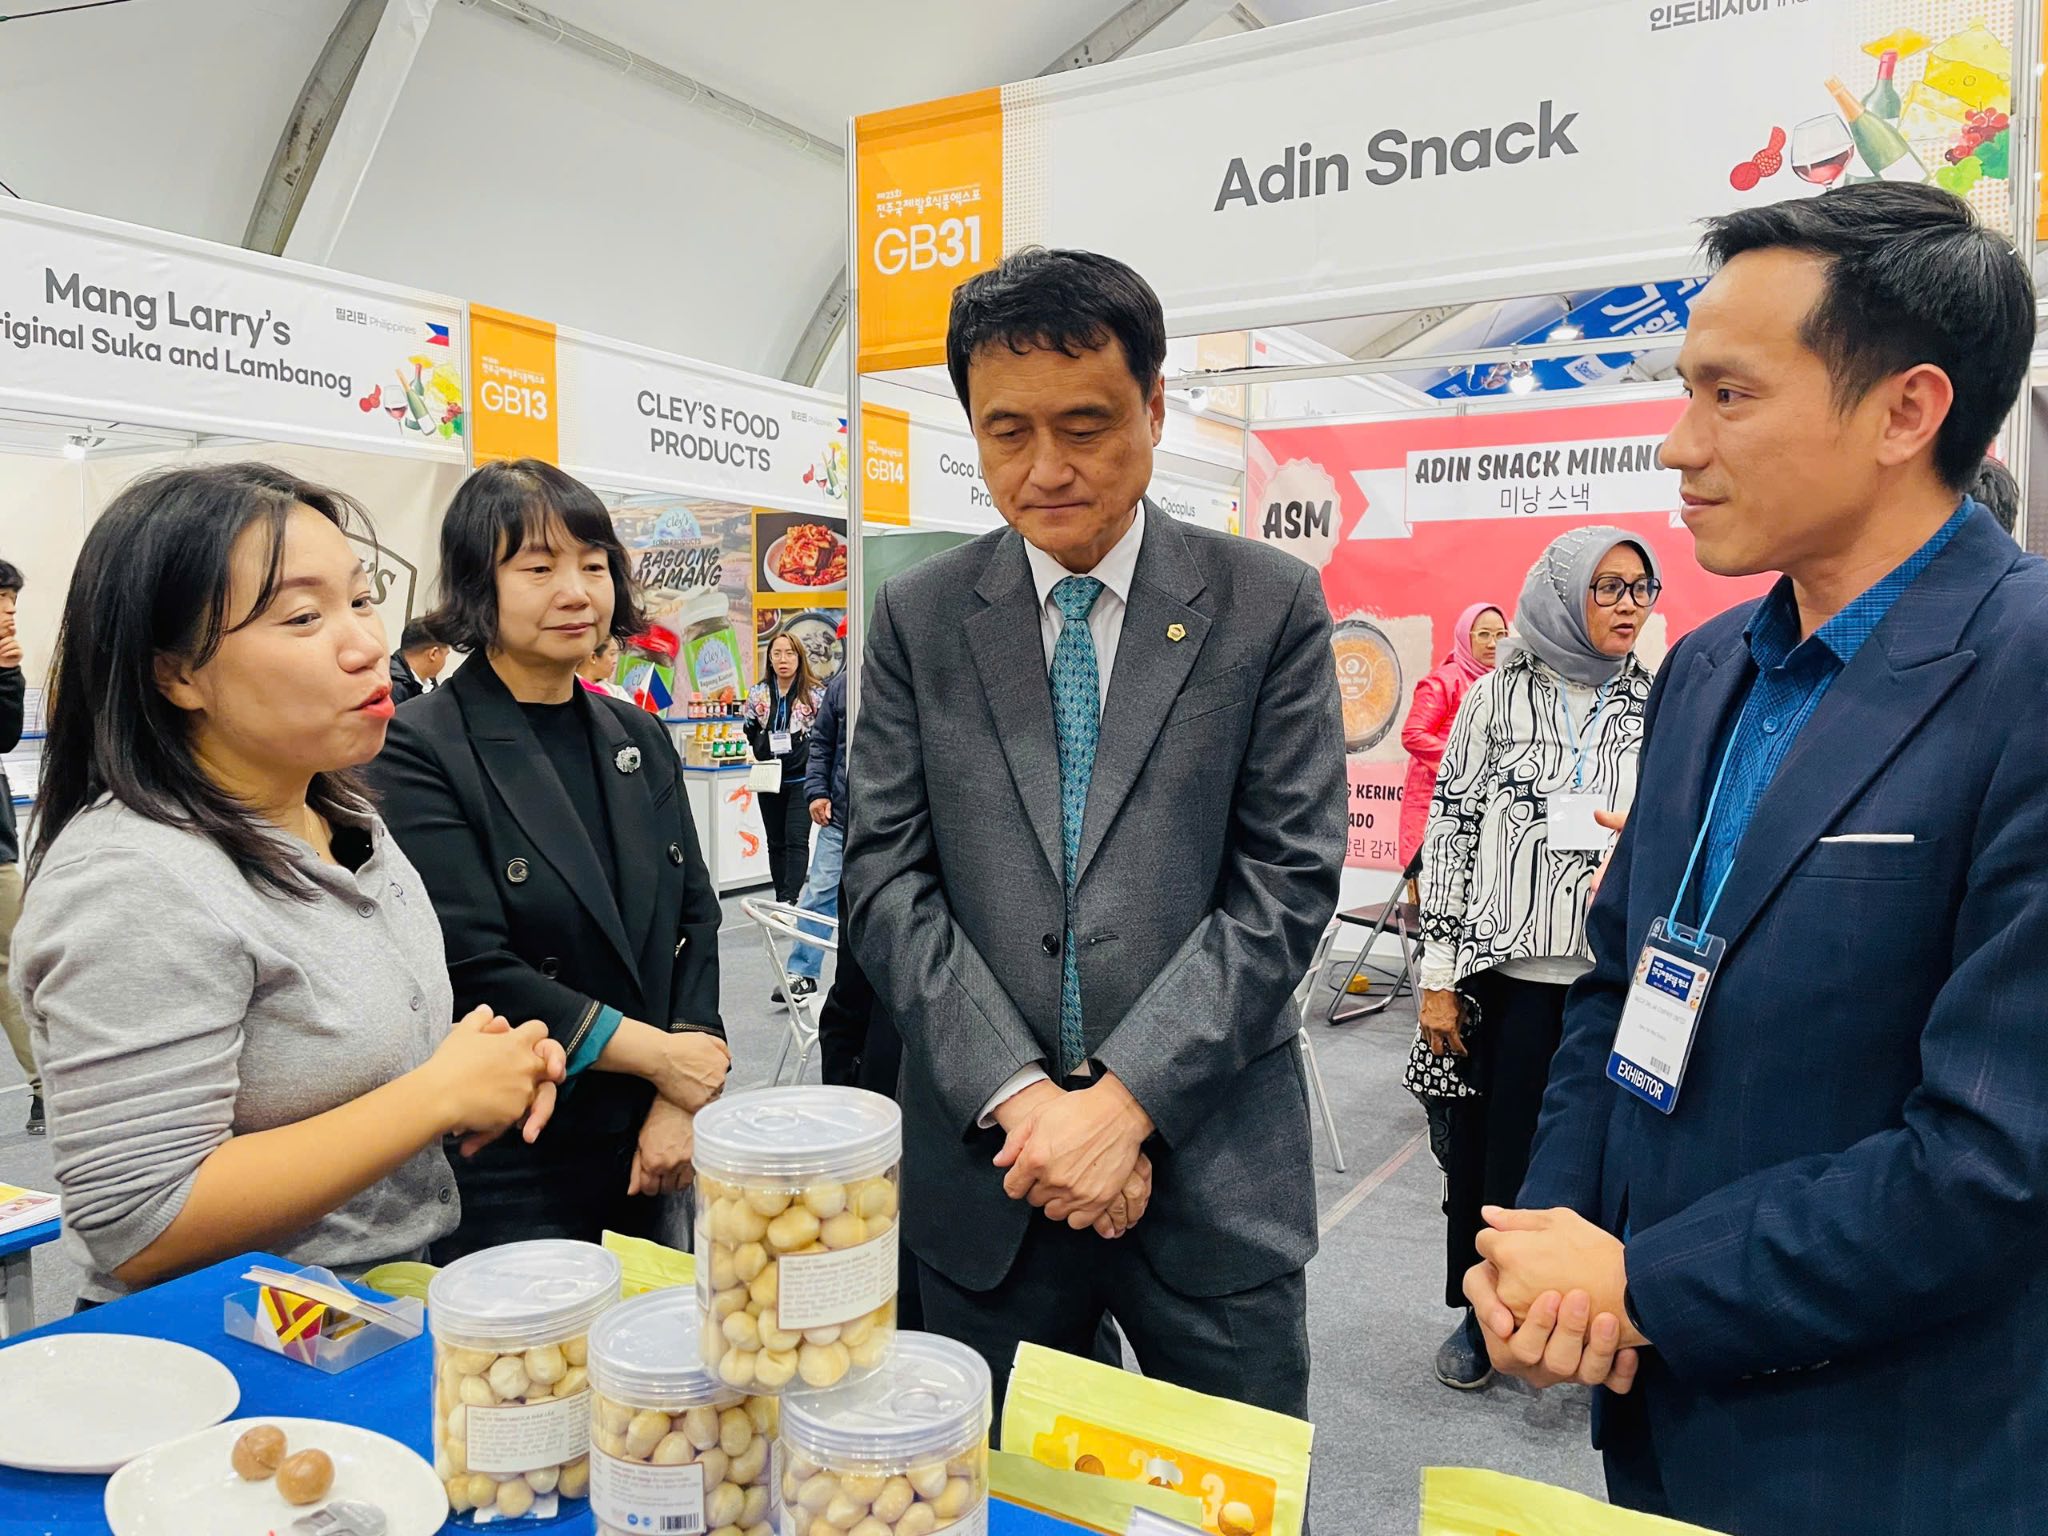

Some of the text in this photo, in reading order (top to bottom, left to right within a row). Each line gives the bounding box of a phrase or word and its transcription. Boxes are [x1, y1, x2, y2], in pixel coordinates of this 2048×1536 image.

[1214, 99, 1580, 212] Adin Snack
[873, 215, 981, 276] GB31
[45, 267, 291, 349] Mang Larry’s
[336, 307, 417, 335] 필리핀 Philippines
[91, 327, 161, 362] Suka
[169, 347, 218, 371] and
[225, 349, 352, 398] Lambanog
[481, 380, 548, 421] GB13
[637, 390, 780, 440] CLEY’S FOOD
[651, 428, 771, 472] PRODUCTS
[940, 453, 974, 478] Coco
[866, 457, 905, 484] GB14
[1415, 456, 1471, 483] ADIN
[1477, 450, 1561, 481] SNACK
[971, 486, 992, 507] Pro
[1160, 496, 1196, 519] Cocoplus
[1501, 483, 1590, 514] 미낭 스낵
[1263, 500, 1333, 540] ASM
[640, 547, 720, 569] BAGOONG
[633, 564, 723, 590] ALAMANG
[1356, 784, 1404, 802] KERING
[1348, 812, 1374, 829] ADO
[1370, 840, 1398, 860] 감자
[1617, 1059, 1664, 1101] EXHIBITOR
[1200, 1473, 1226, 1529] 3
